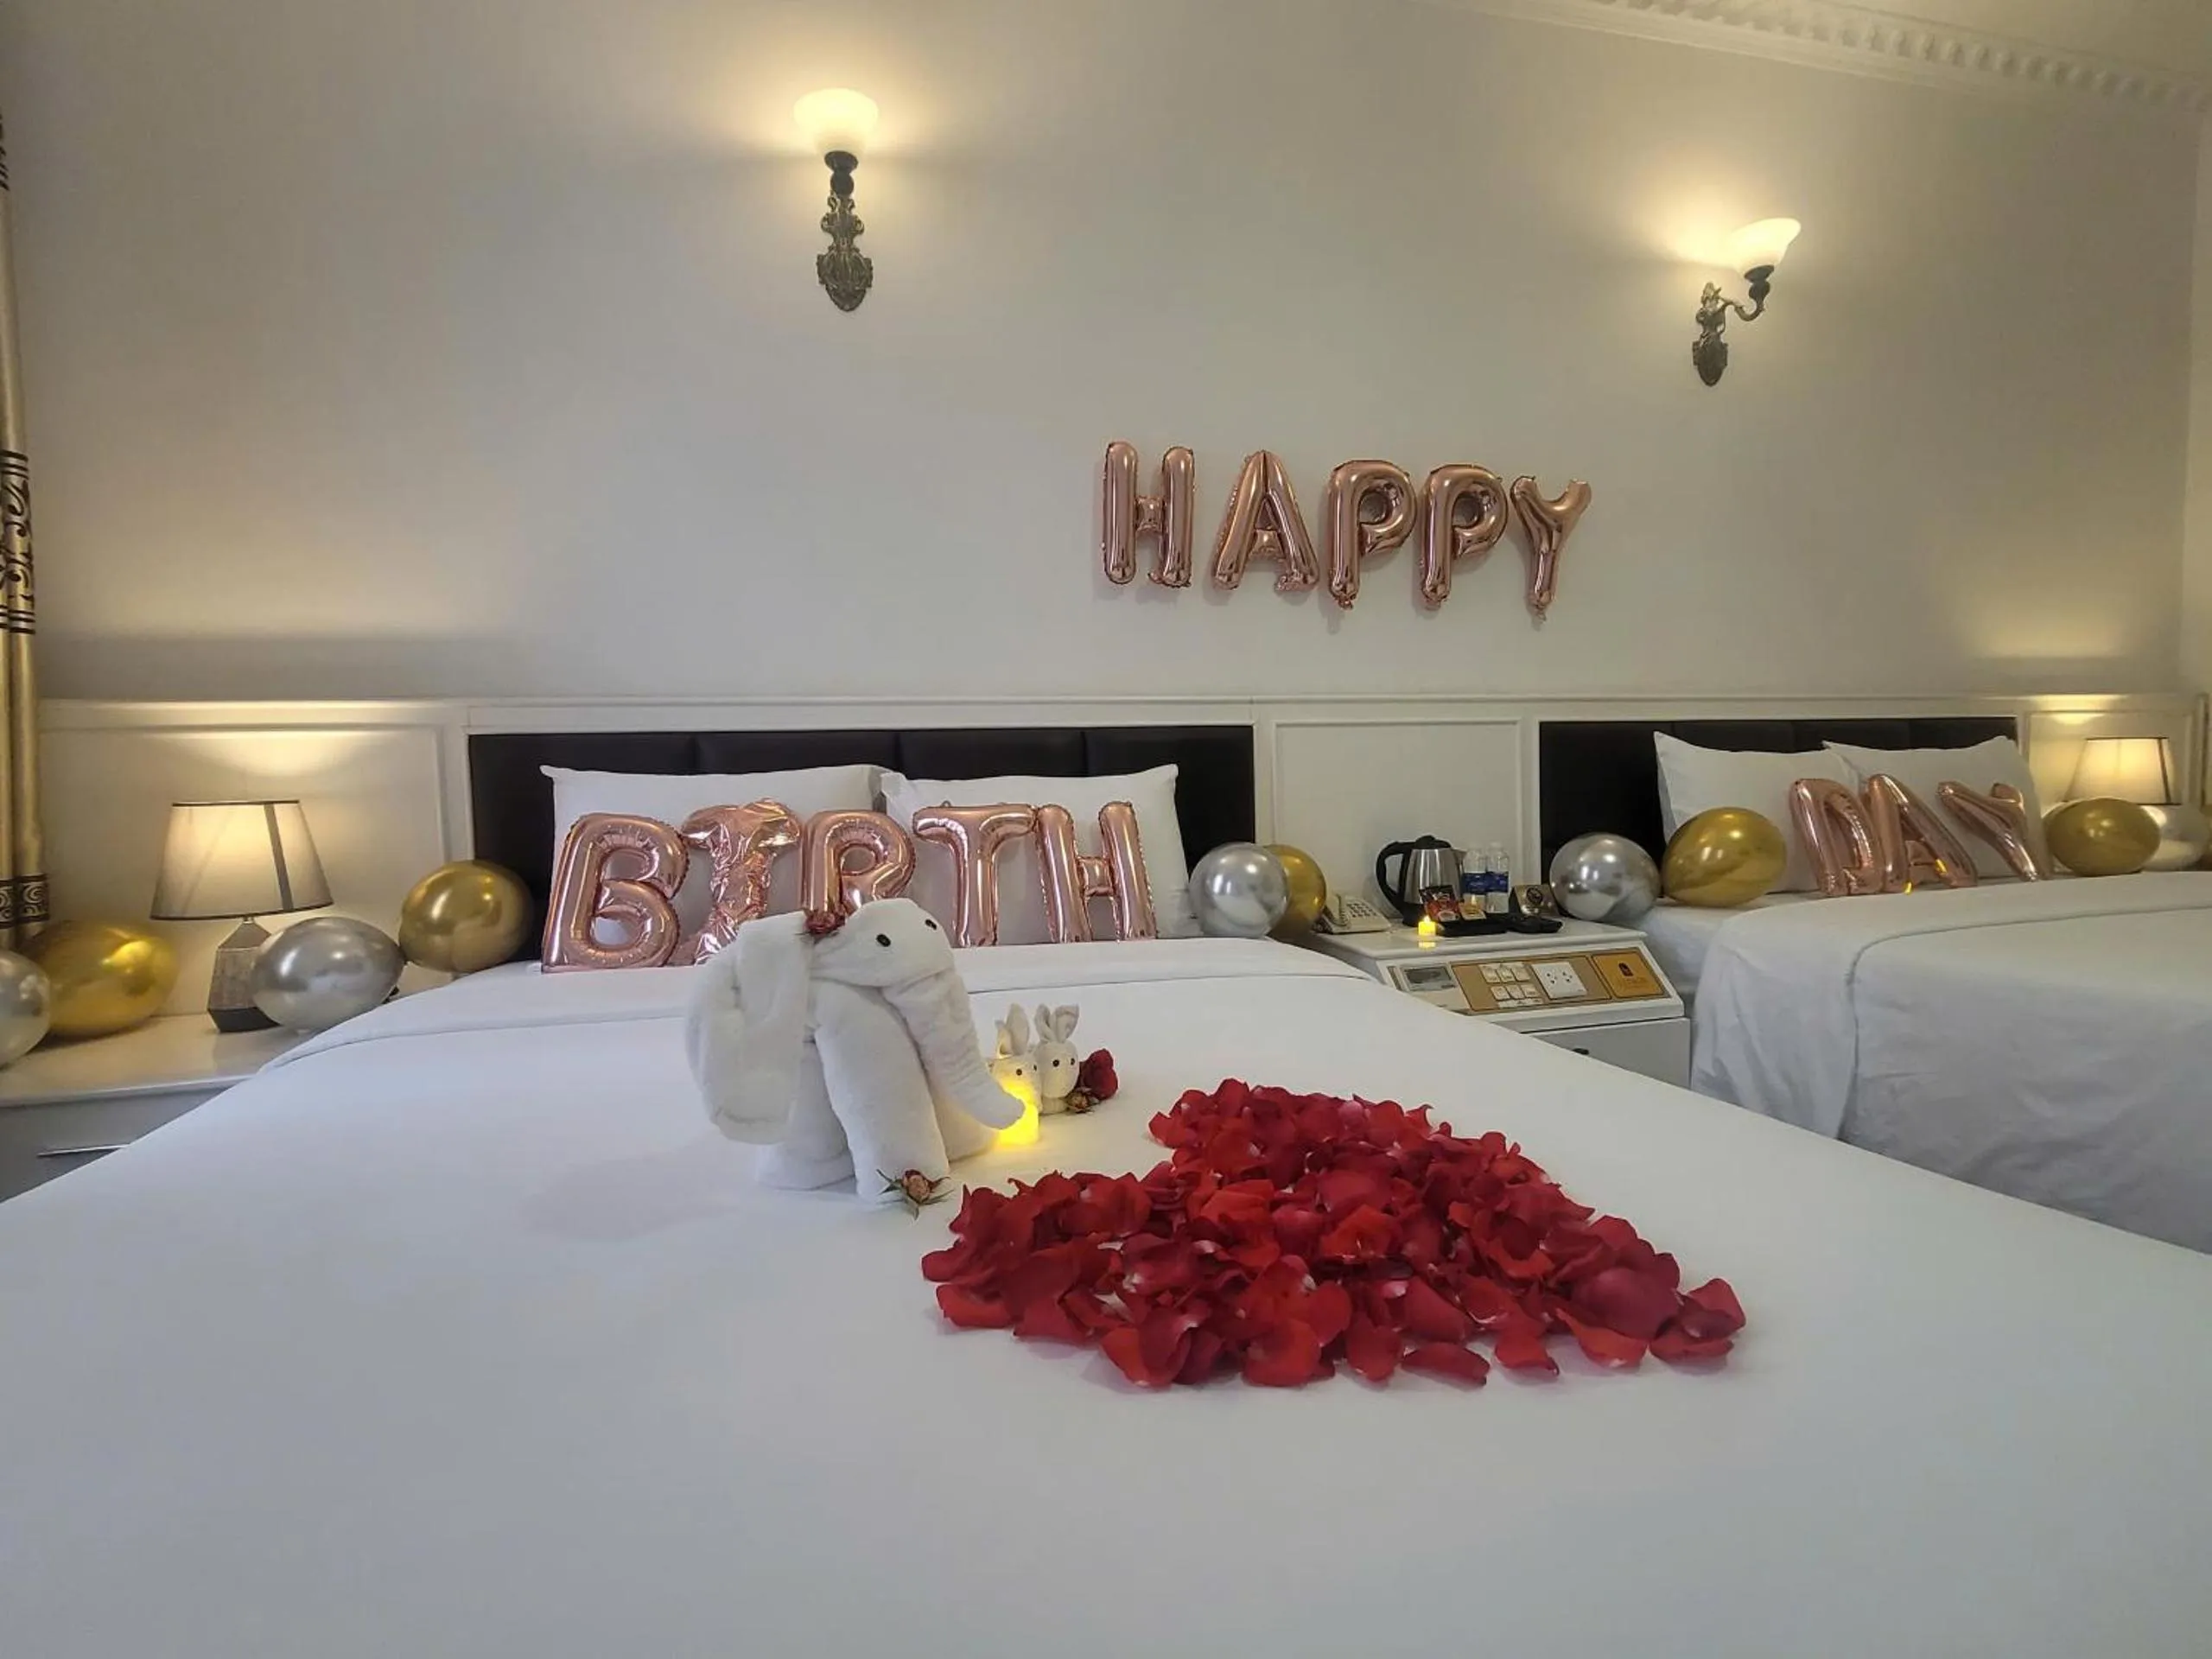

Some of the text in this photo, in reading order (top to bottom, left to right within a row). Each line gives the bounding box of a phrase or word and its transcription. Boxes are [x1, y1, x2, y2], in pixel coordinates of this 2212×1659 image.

[1102, 442, 1592, 620] HAPPY
[542, 798, 1160, 973] BIRTH
[1789, 773, 2046, 897] DAY
